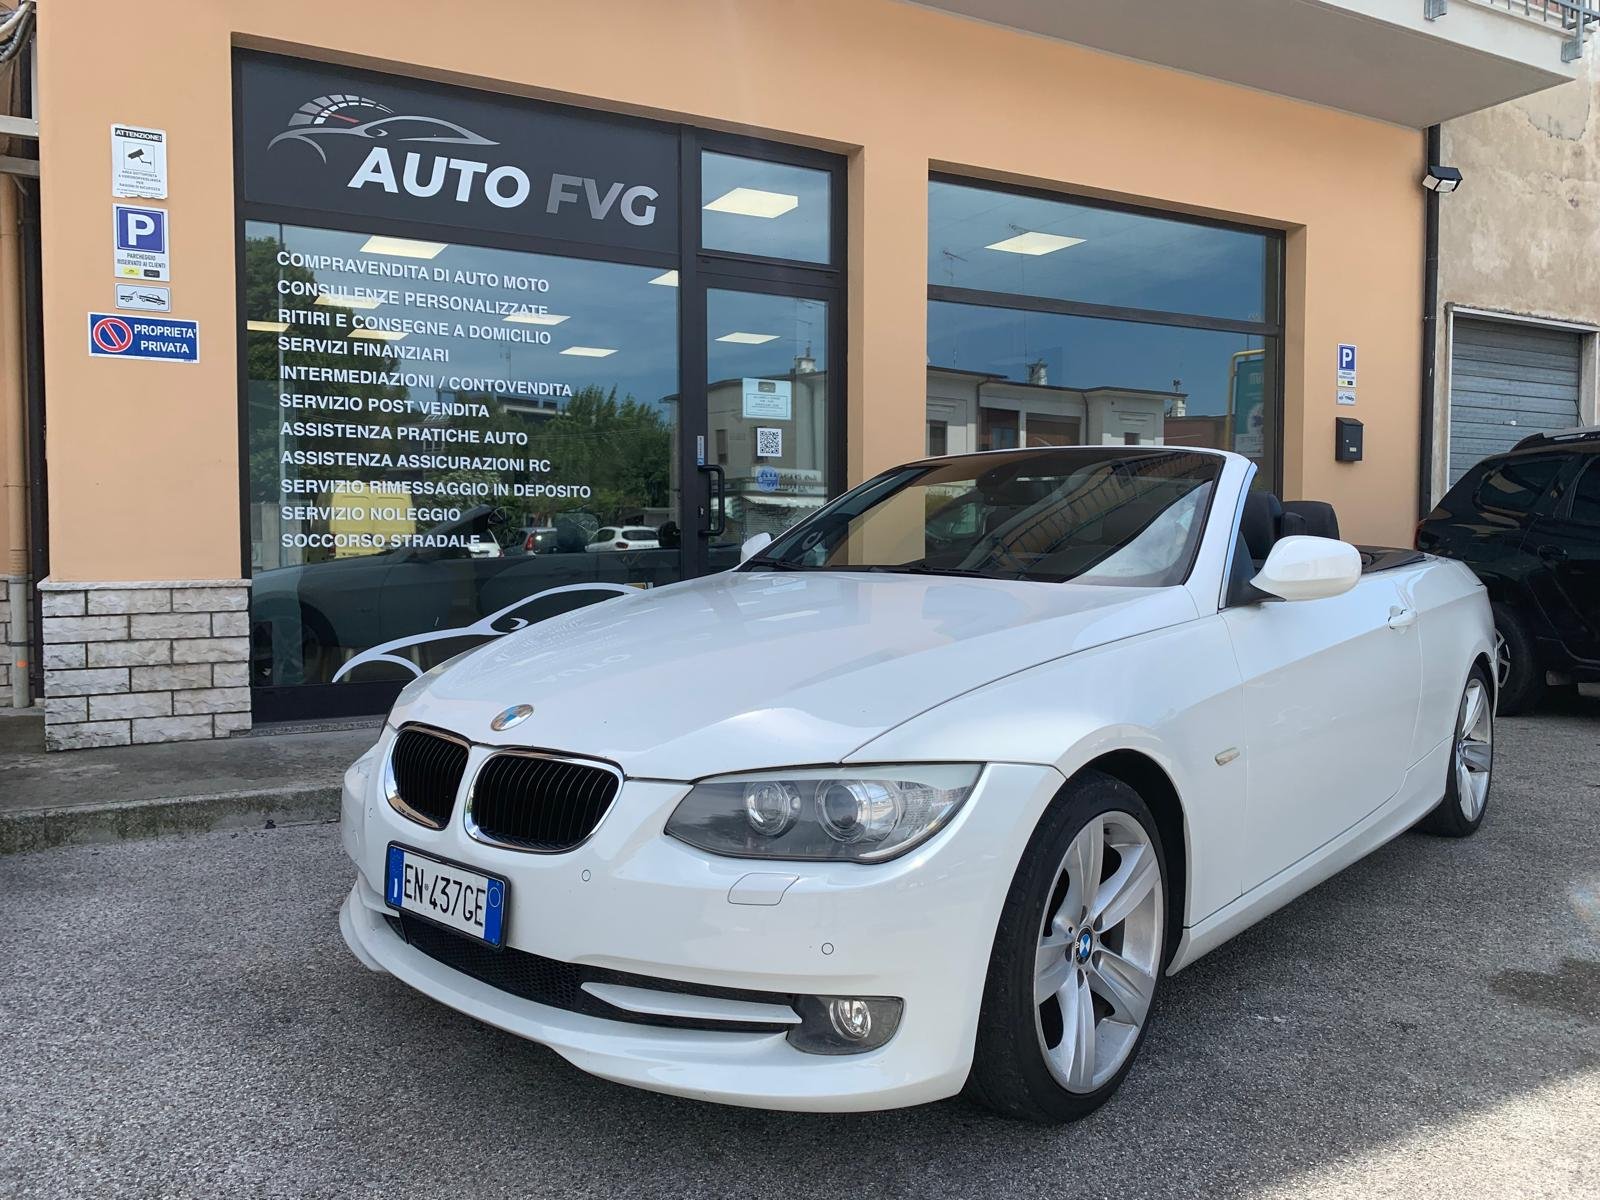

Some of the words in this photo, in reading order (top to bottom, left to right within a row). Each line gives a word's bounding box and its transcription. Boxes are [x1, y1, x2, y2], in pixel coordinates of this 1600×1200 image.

[115, 129, 162, 142] ATTENZIONE!
[347, 146, 531, 208] AUTO
[546, 173, 659, 226] FVG
[127, 213, 155, 246] P
[276, 251, 429, 280] COMPRAVENDITA
[434, 267, 449, 282] DI
[454, 270, 499, 288] AUTO
[503, 276, 549, 293] MOTO
[277, 280, 399, 306] CONSULENZE
[404, 292, 548, 317] PERSONALIZZATE
[134, 324, 196, 338] PROPRIETA'
[278, 309, 332, 327] RITIRI
[336, 314, 347, 328] E
[352, 315, 449, 336] CONSEGNE
[453, 324, 465, 338] A
[469, 325, 551, 345] DOMICILIO
[140, 341, 189, 354] PRIVATA
[278, 337, 348, 354] SERVIZI
[353, 342, 449, 362] FINANZIARI
[1342, 348, 1353, 367] P
[280, 366, 434, 389] INTERMEDIAZIONI
[438, 375, 445, 389] /
[449, 376, 572, 397] CONTOVENDITA
[280, 393, 363, 411] SERVIZIO
[369, 398, 414, 414] POST
[419, 402, 490, 418] VENDITA
[280, 422, 393, 440] ASSISTENZA
[397, 427, 480, 444] PRATICHE
[484, 431, 528, 445] AUTO
[280, 451, 393, 468] ASSISTENZA
[397, 454, 525, 472] ASSICURAZIONI
[529, 458, 551, 472] RC
[281, 479, 364, 494] SERVIZIO
[370, 481, 489, 497] RIMESSAGGIO
[493, 484, 509, 497] IN
[513, 484, 592, 499] DEPOSITO
[281, 507, 364, 521] SERVIZIO
[370, 508, 461, 522] NOLEGGIO
[281, 533, 386, 549] SOCCORSO
[390, 534, 480, 548] STRADALE
